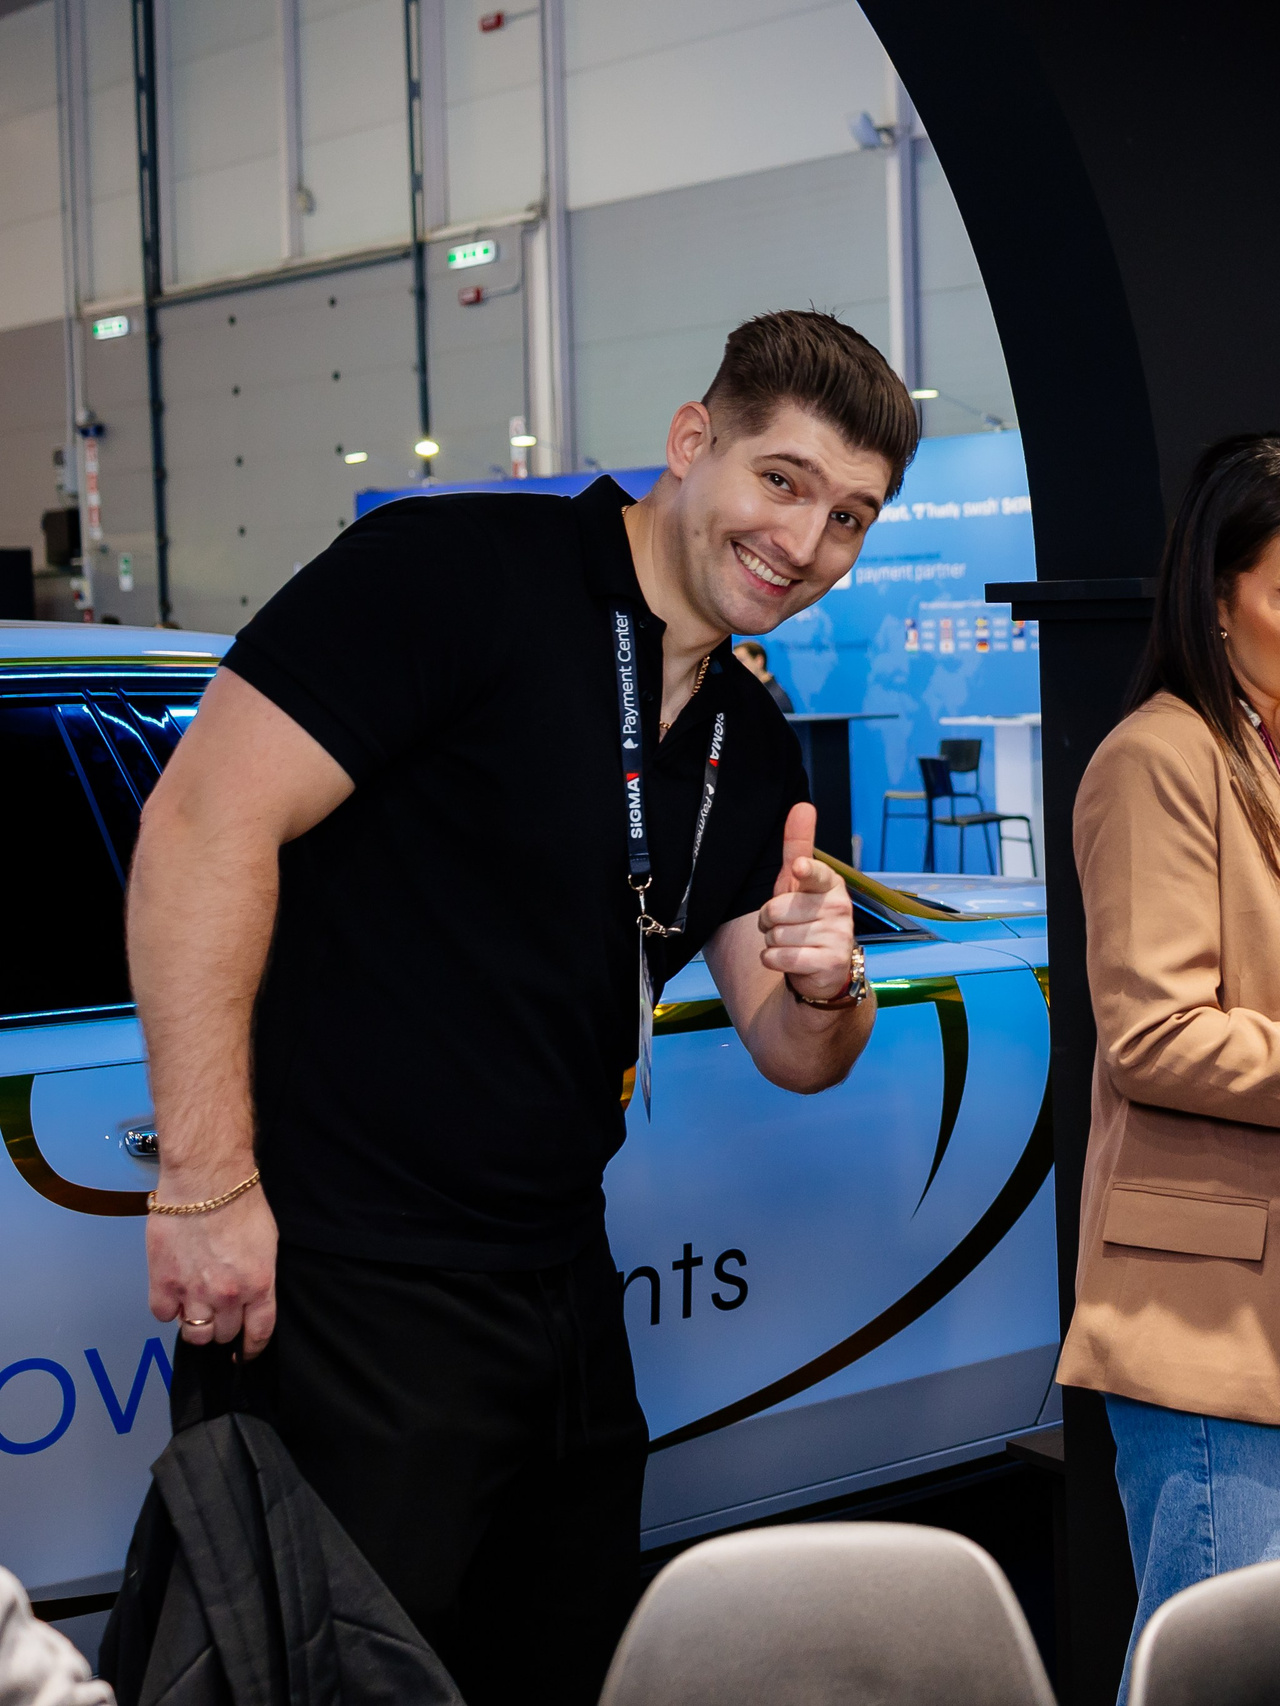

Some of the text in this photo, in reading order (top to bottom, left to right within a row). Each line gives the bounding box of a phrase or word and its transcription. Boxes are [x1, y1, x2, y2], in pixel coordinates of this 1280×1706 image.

[856, 563, 967, 585] payment partner
[615, 611, 638, 734] Payment Center
[709, 713, 724, 760] SiGMA
[627, 777, 643, 838] SiGMA
[616, 1243, 748, 1326] nts
